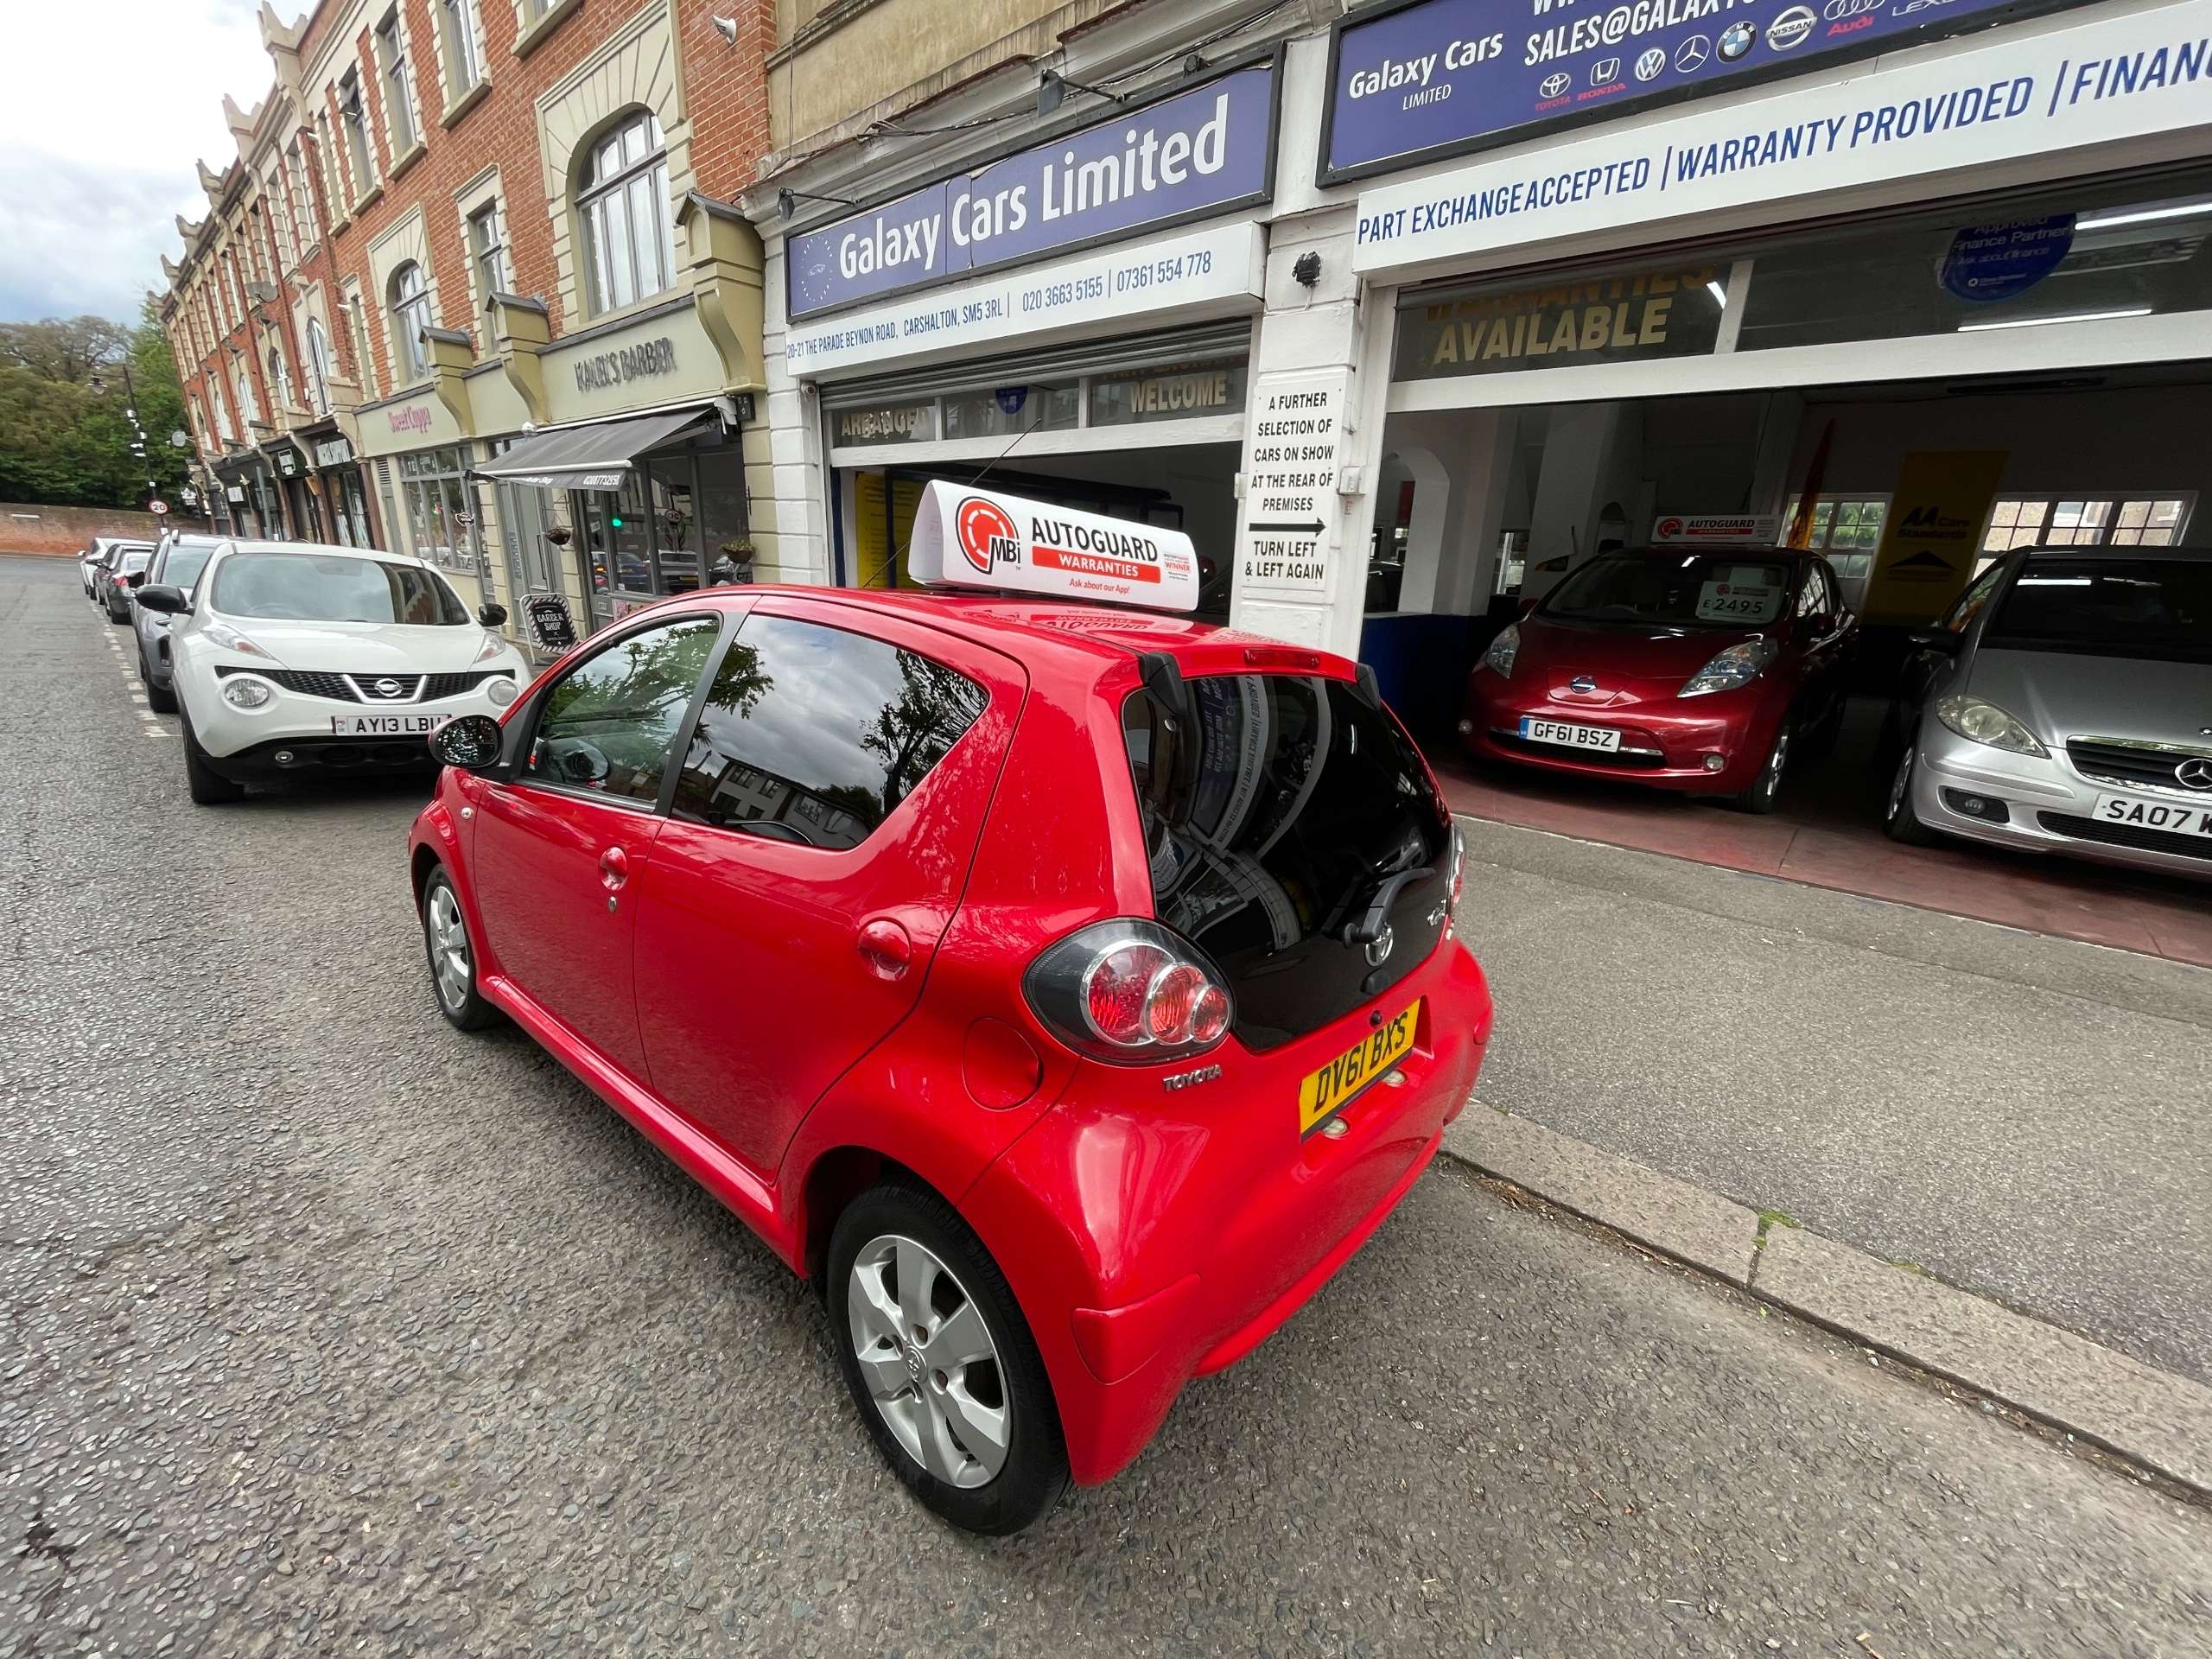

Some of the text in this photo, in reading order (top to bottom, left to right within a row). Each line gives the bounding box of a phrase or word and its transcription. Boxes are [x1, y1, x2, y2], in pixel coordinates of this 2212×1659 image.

[1524, 0, 1756, 66] SALES@GALAX
[1770, 21, 1812, 37] NISSAN
[1826, 16, 1874, 36] Audi
[1349, 33, 1504, 99] Galaxy Cars
[1402, 84, 1452, 111] LIMITED
[1577, 83, 1627, 102] HONDA
[1535, 96, 1571, 111] TOYOTA
[1357, 209, 1407, 245] PART
[1676, 115, 1847, 182] WARRANTY
[1849, 76, 2035, 149] PROVIDED
[839, 92, 1229, 279] Galaxy Cars Limited
[787, 251, 1211, 359] 20-21 THE PARADE BEYNON ROAD, CARSHALTON, SM5 3RL 020 3663 5155 07361 554 778
[1432, 297, 1673, 365] AVAILABLE
[620, 337, 677, 381] BARBER
[1130, 372, 1227, 414] WELCOME
[1268, 391, 1328, 410] A FURTHER
[1257, 418, 1332, 436] SELECTION OF
[1255, 445, 1334, 462] CARS ON SHOW
[1251, 473, 1333, 489] AT THE REAR OF
[1262, 497, 1313, 512] PREMISES
[1688, 519, 1755, 528] AUTOGUARD
[1902, 505, 1939, 526] AA
[1032, 517, 1158, 563] AUTOGUARD
[1254, 541, 1317, 557] TURN LEFT
[1058, 553, 1139, 577] WARRANTIES
[1165, 561, 1190, 571] WINNER
[1245, 562, 1324, 580] & LEFT AGAIN
[1070, 578, 1130, 595] Ask about our App!
[536, 613, 564, 623] BARBER
[543, 622, 562, 631] SHOP
[355, 718, 399, 733] AY13
[1534, 722, 1613, 747] GF61 BSZ
[2107, 800, 2192, 829] SA07
[1313, 1011, 1408, 1114] DV61 BXS
[1163, 1064, 1222, 1092] TOYOTA
